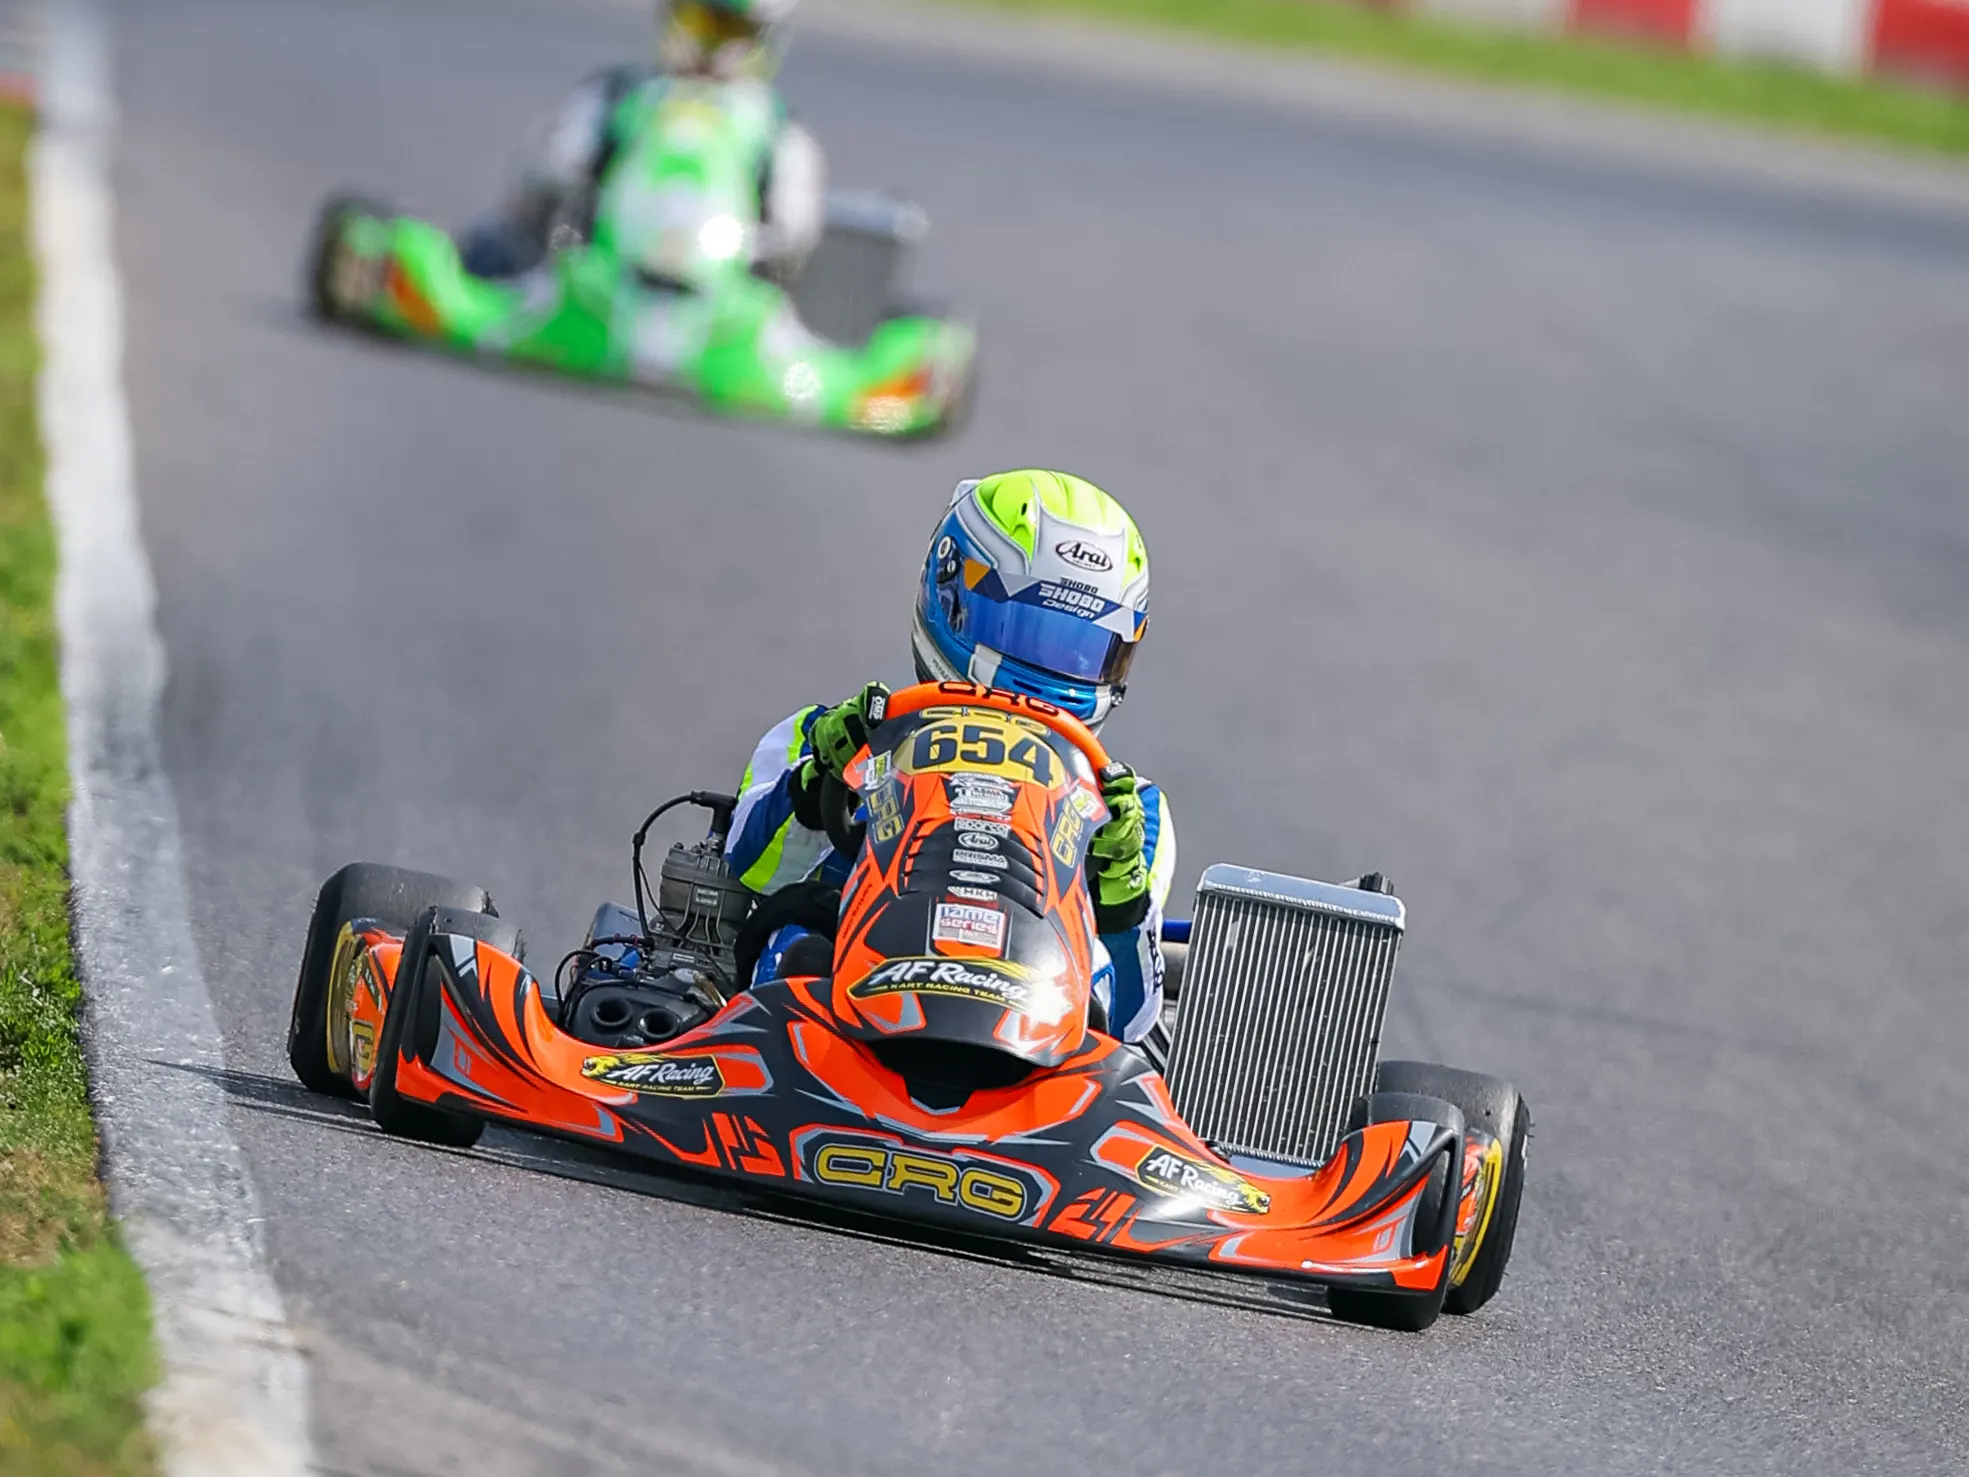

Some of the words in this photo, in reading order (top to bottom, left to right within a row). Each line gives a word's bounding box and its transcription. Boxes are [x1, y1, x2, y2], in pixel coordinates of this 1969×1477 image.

[1059, 542, 1108, 567] Arai
[1038, 583, 1106, 613] SHOBO
[1042, 598, 1096, 619] Design
[912, 724, 1053, 787] 654
[868, 961, 935, 985] AF
[929, 961, 1028, 999] Racing
[606, 1064, 659, 1081] AF
[648, 1063, 715, 1086] Racing
[815, 1144, 1027, 1220] CRG
[1147, 1154, 1183, 1180] AF
[1180, 1165, 1244, 1205] Racing
